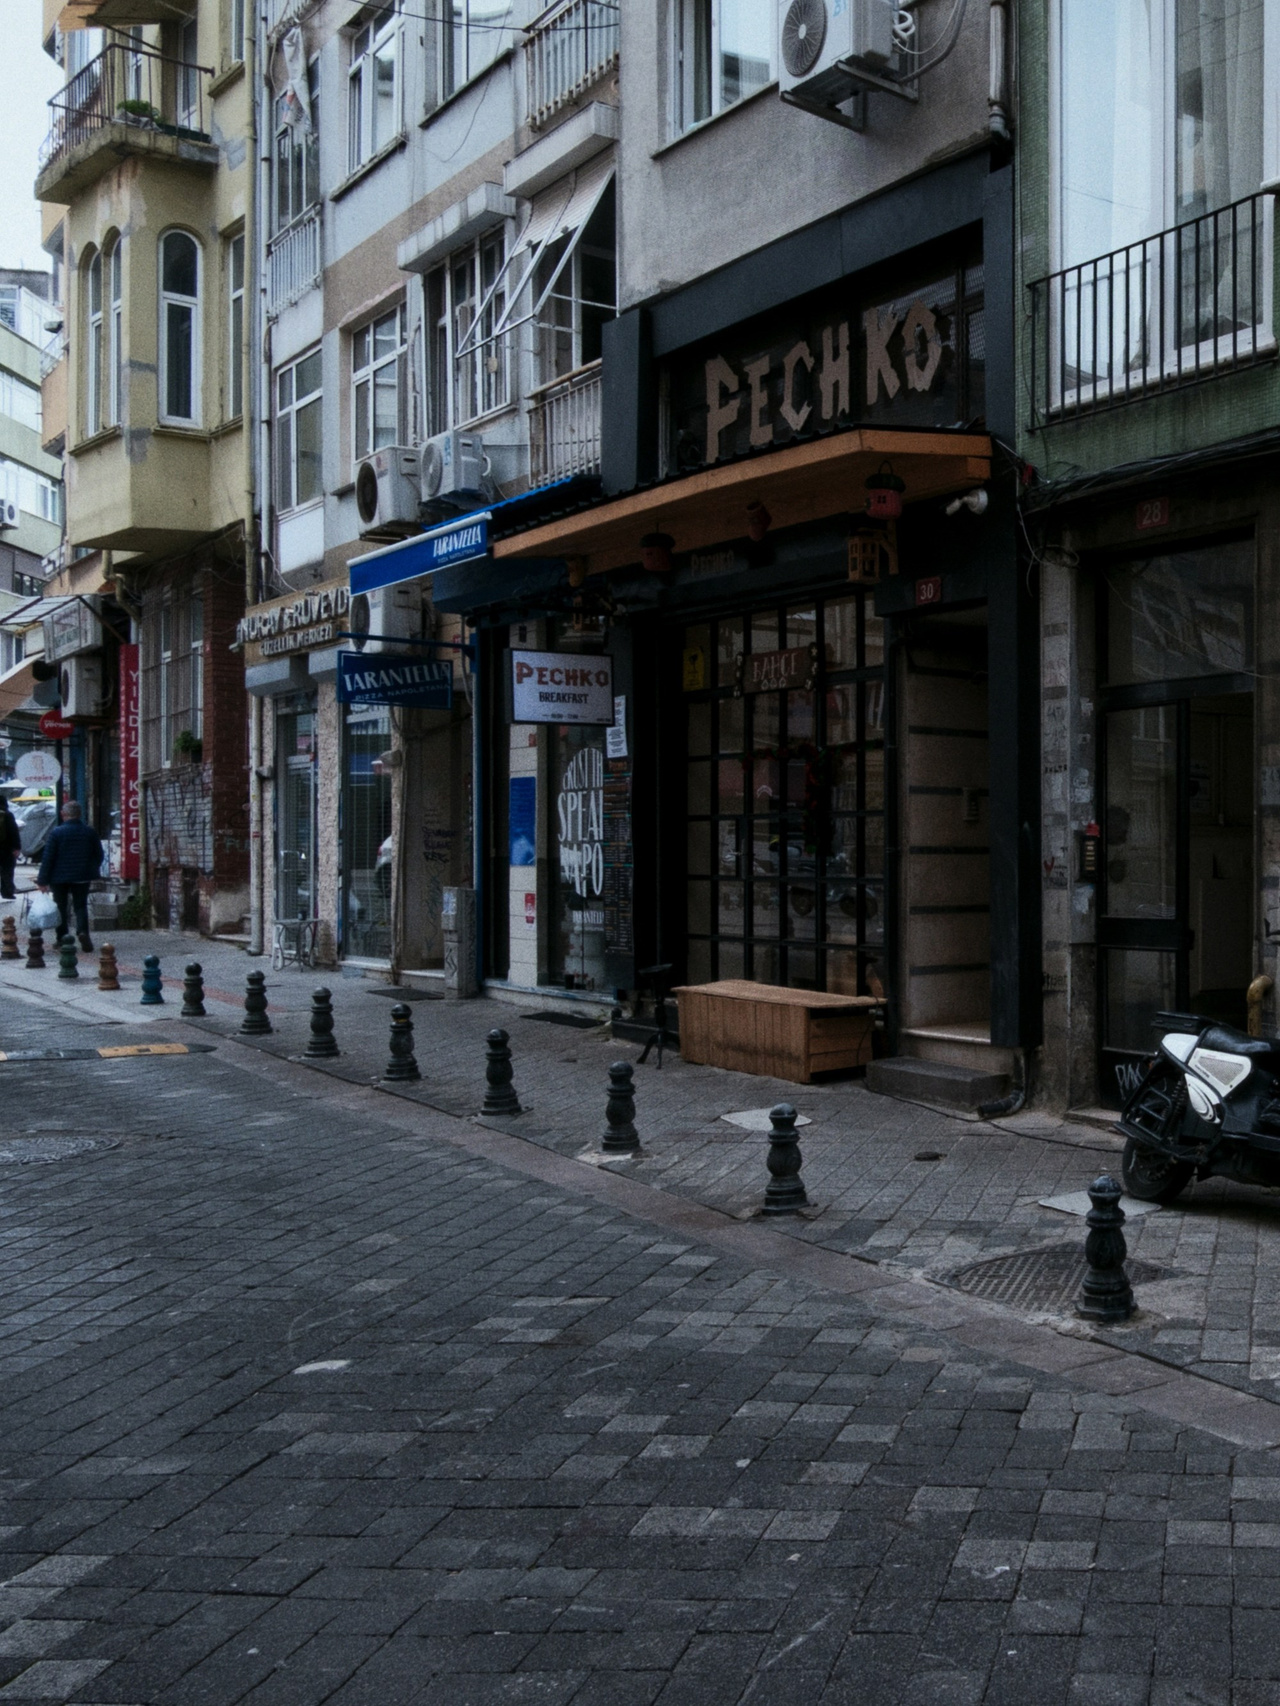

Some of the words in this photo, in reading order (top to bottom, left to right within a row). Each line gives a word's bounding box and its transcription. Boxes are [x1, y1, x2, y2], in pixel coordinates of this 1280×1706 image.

[705, 299, 942, 463] PECHKO
[1143, 501, 1161, 525] 28
[433, 525, 482, 558] TARANTELLA
[920, 583, 934, 600] 30
[344, 663, 449, 692] TARANTELLA
[516, 662, 609, 687] PECHKO
[355, 692, 384, 701] PIZZA
[387, 683, 449, 697] NAPOLETANA
[539, 692, 589, 704] BREAKFAST
[557, 790, 604, 842] SPEA
